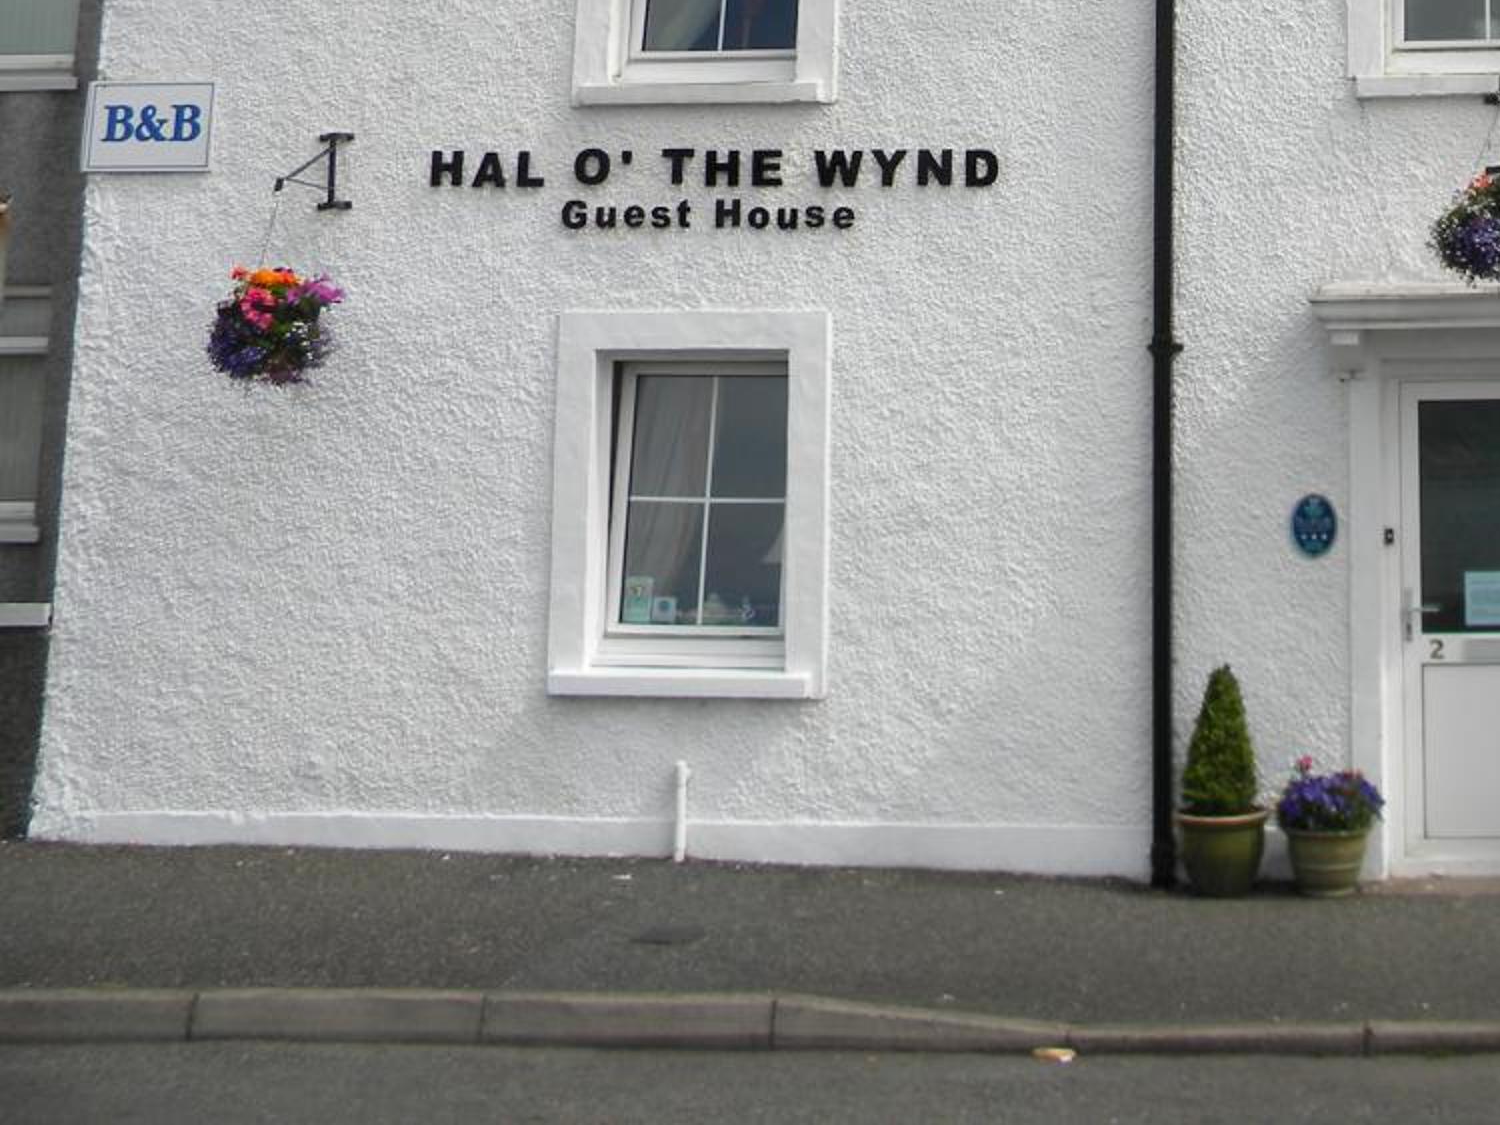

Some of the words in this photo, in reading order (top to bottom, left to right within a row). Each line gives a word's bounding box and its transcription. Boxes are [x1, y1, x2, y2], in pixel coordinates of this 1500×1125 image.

[101, 103, 202, 143] B&B
[429, 150, 545, 190] HAL
[573, 148, 633, 188] O'
[661, 148, 784, 189] THE
[813, 148, 1000, 189] WYND
[561, 199, 692, 231] Guest
[714, 198, 857, 231] House
[1429, 638, 1445, 660] 2
